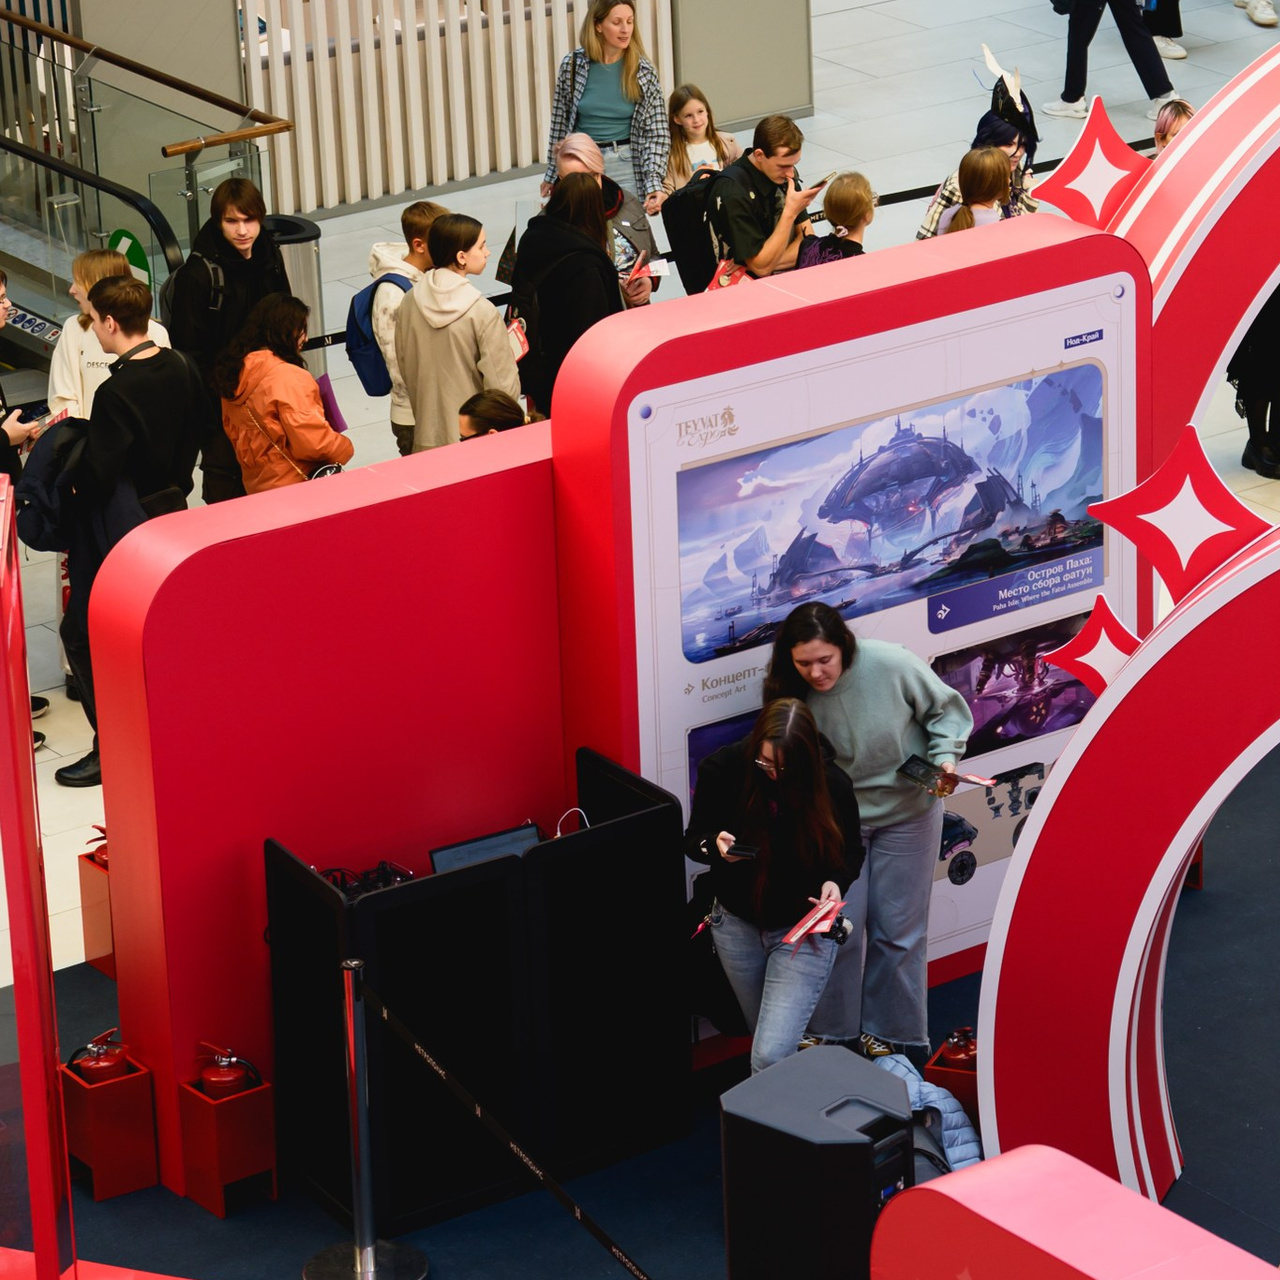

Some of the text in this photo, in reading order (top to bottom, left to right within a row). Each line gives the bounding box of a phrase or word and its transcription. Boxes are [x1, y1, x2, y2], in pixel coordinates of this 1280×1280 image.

[1066, 331, 1100, 347] Нод-Край
[86, 361, 110, 369] DESCE
[675, 412, 720, 438] TEYVAT
[1028, 554, 1093, 581] Остров Паха:
[998, 565, 1093, 601] Место сбора фатуи
[701, 666, 771, 692] Концепт-
[702, 684, 747, 703] Concept Art
